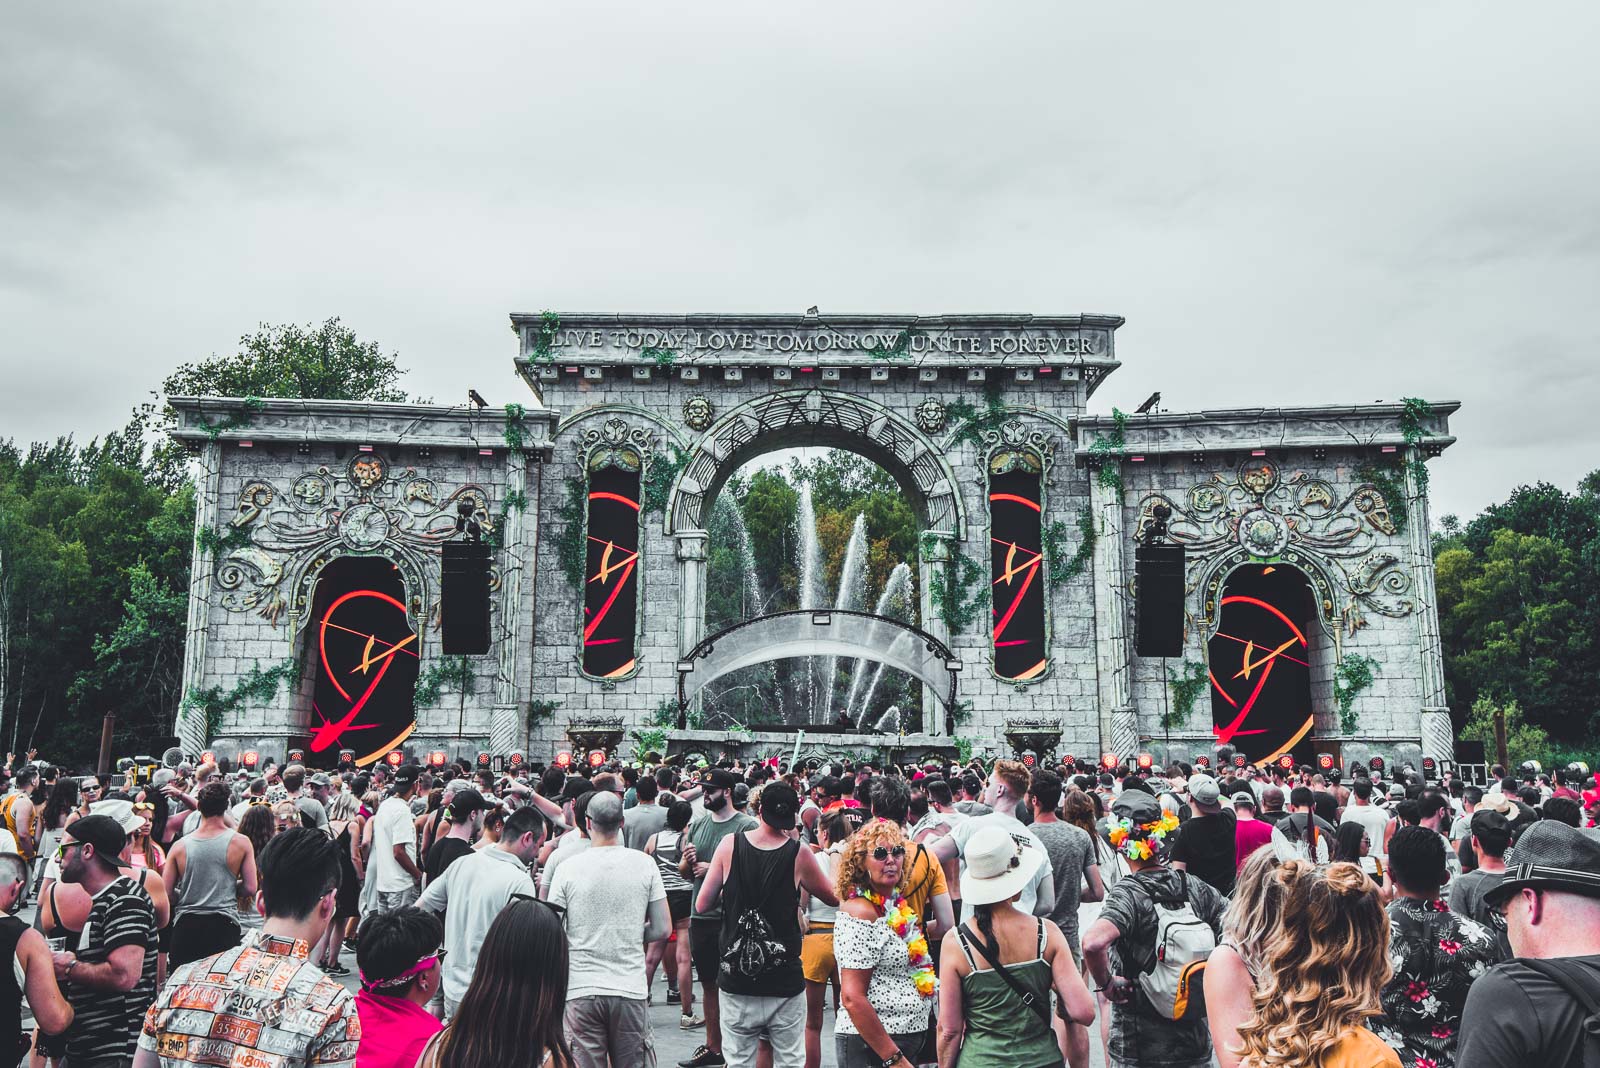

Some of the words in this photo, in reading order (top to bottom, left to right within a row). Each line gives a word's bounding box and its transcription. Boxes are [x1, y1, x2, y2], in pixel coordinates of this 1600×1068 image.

[549, 330, 603, 347] LIVE
[610, 330, 687, 350] TODAY
[694, 332, 754, 351] LOVE
[761, 333, 899, 352] TOMORROW
[909, 335, 983, 354] UNITE
[988, 336, 1095, 355] FOREVER
[232, 991, 262, 1012] 3104
